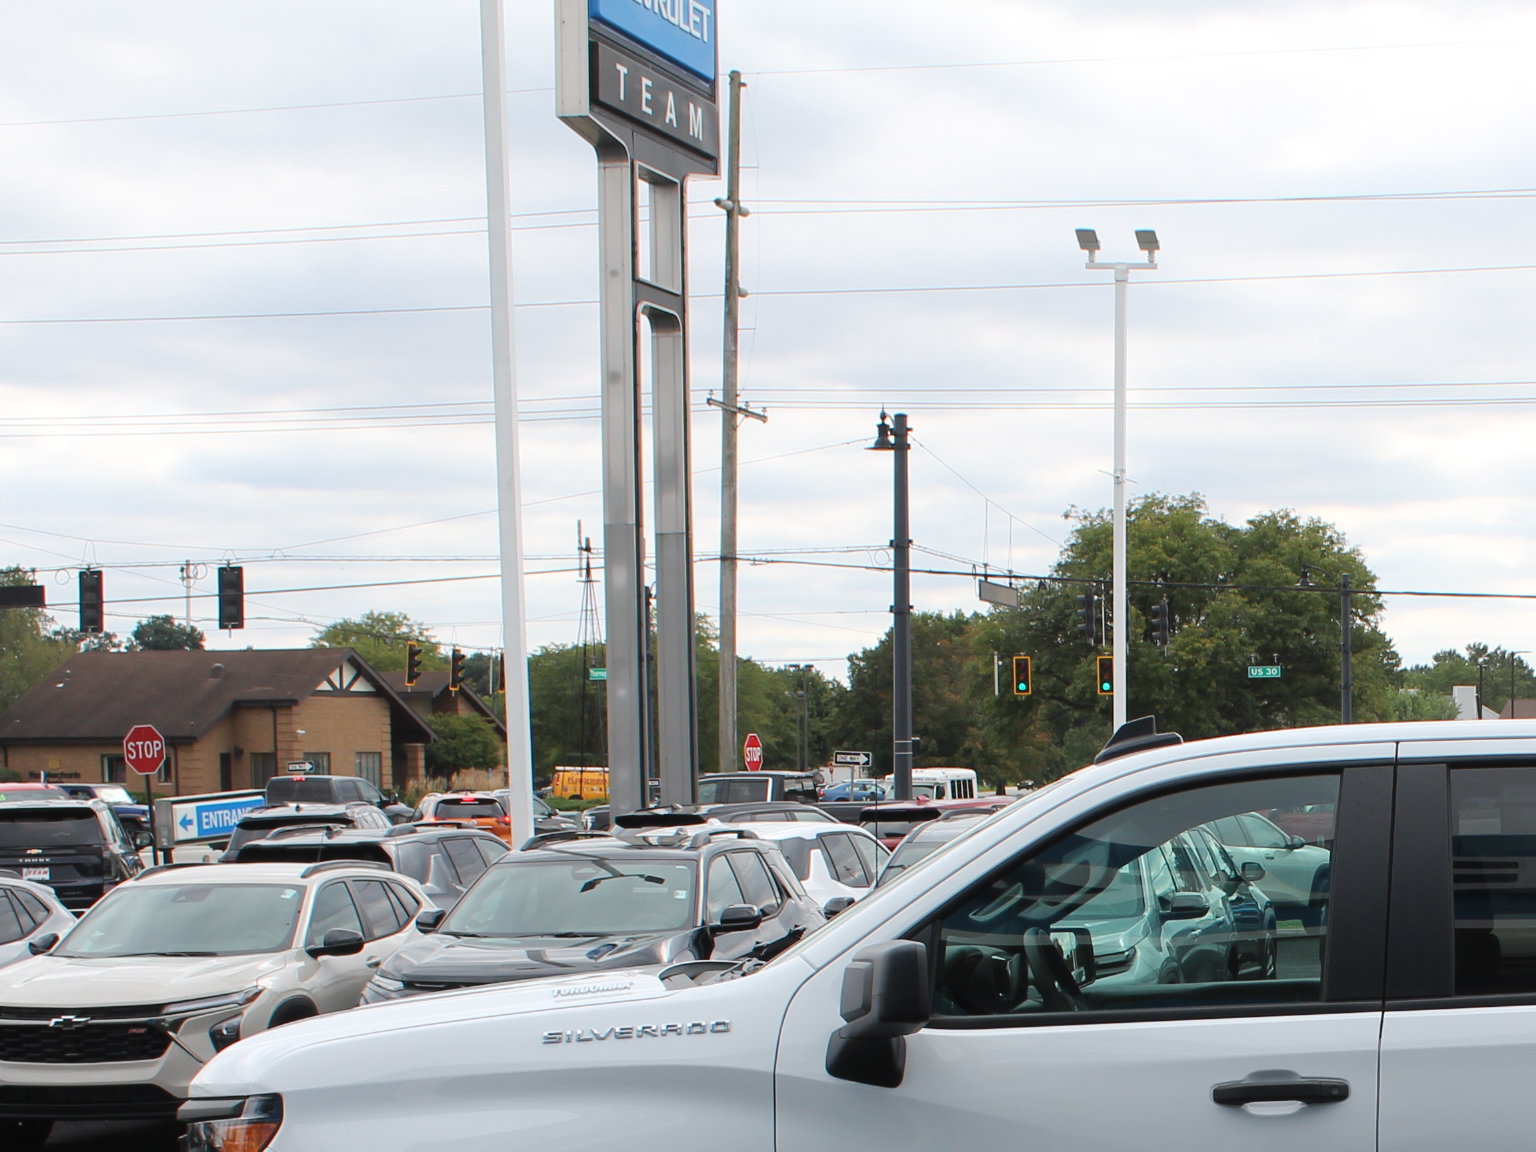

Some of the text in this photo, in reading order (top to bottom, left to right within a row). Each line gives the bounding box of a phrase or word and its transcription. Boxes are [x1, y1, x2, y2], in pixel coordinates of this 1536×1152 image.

[615, 63, 704, 141] TEAM
[1251, 667, 1278, 676] US 30
[127, 740, 162, 760] STOP
[746, 747, 761, 763] STOP
[542, 1019, 732, 1045] SILVERADO
